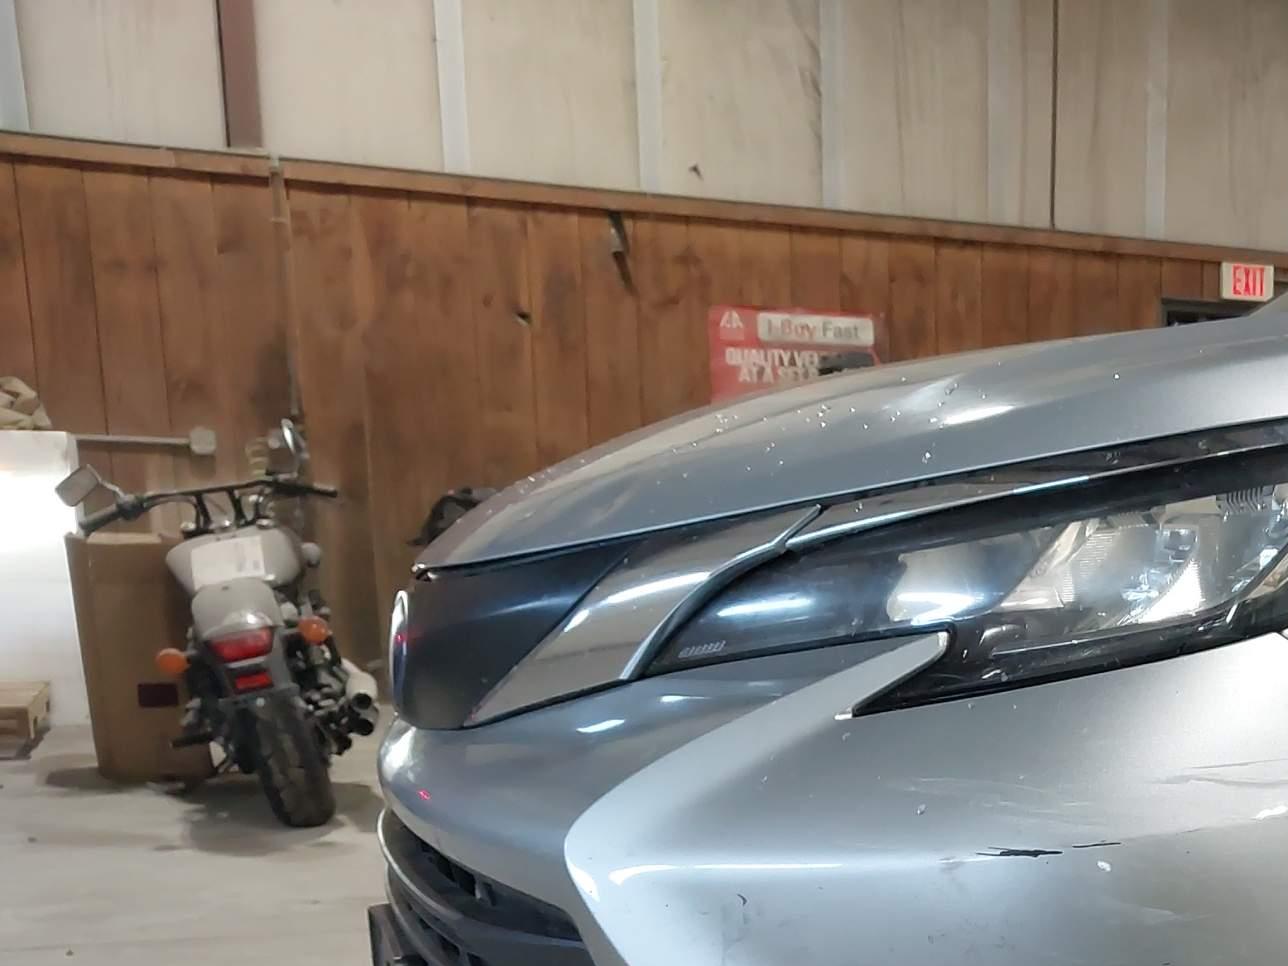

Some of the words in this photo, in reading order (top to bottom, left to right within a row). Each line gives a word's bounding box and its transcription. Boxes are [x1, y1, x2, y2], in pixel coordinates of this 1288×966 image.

[1232, 264, 1265, 296] EXIT
[822, 320, 859, 339] Fast
[725, 347, 789, 367] QUALITY
